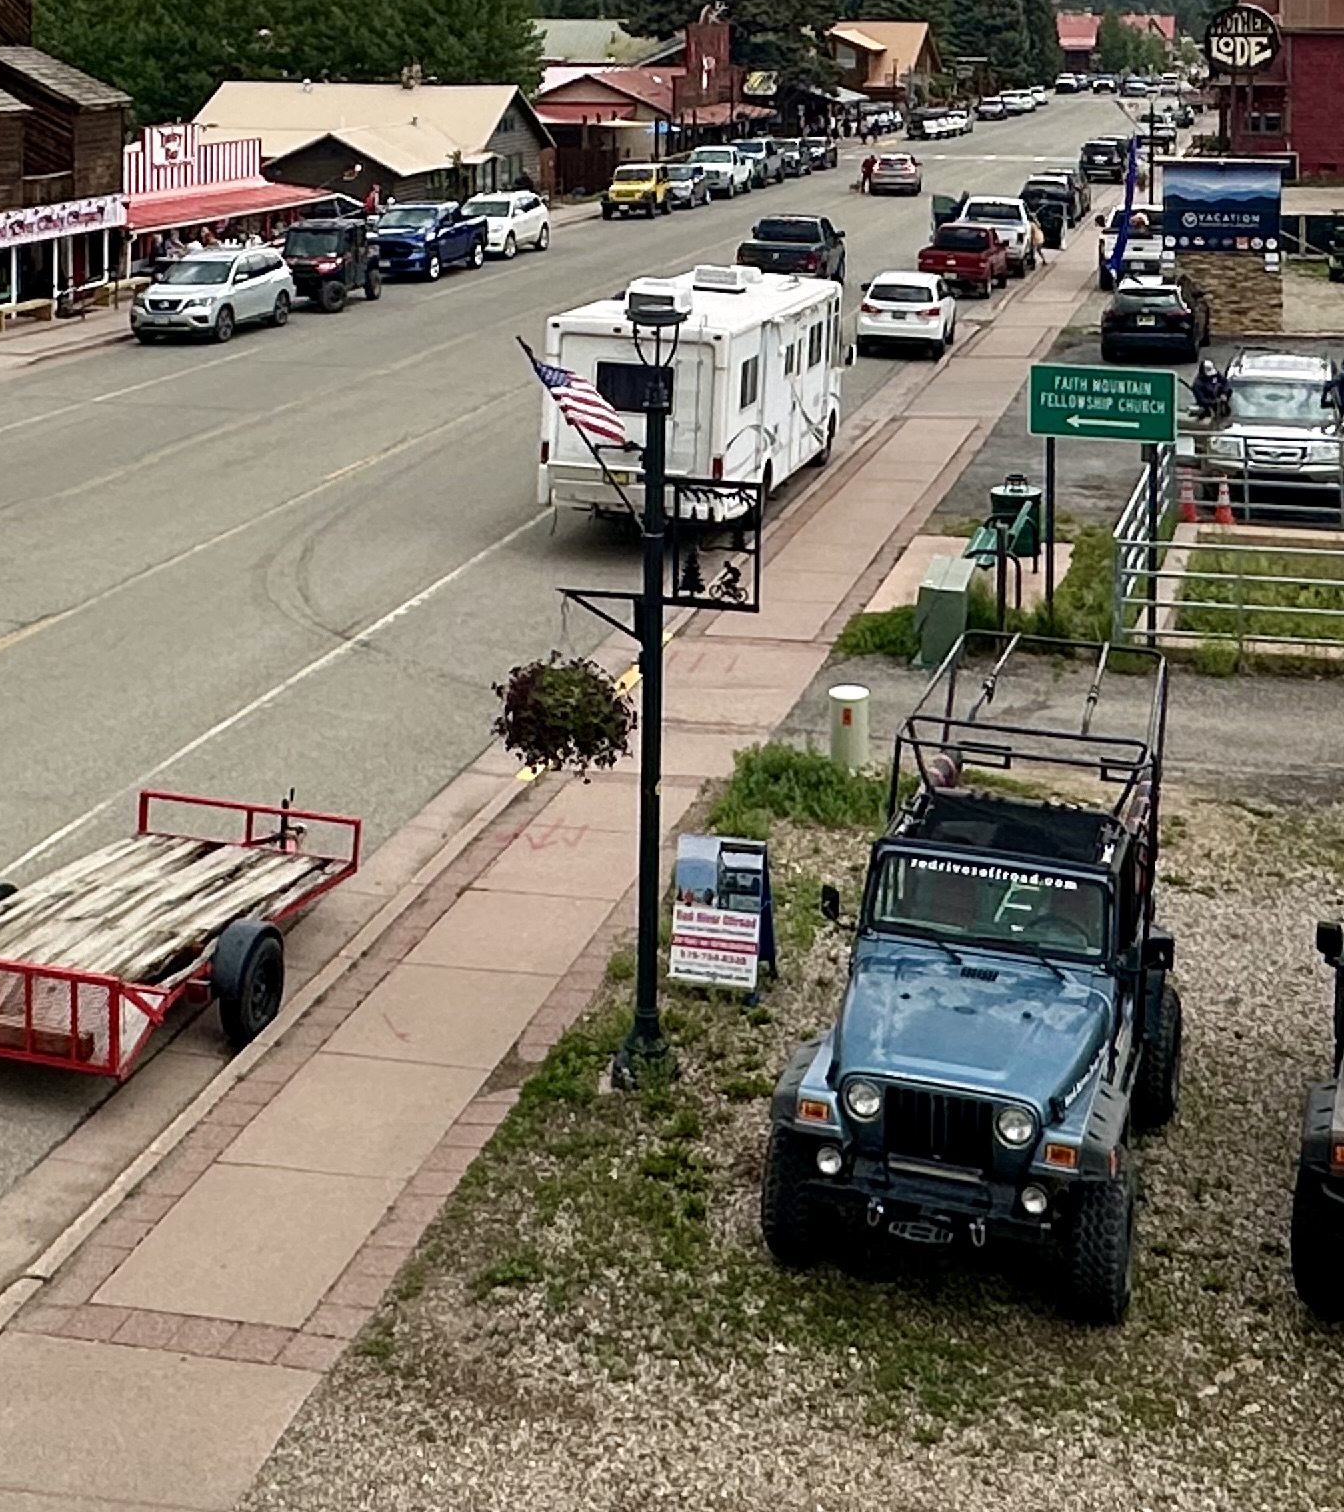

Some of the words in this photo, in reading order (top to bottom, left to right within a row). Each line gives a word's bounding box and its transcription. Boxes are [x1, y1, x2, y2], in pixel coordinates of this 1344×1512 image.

[1209, 36, 1272, 66] LODE
[1197, 212, 1260, 223] VACATION
[1054, 375, 1088, 392] FAITH
[1092, 378, 1152, 396] MOUNTAIN
[1040, 391, 1114, 410] FELLOWSHIP
[1118, 398, 1166, 414] CHURCH
